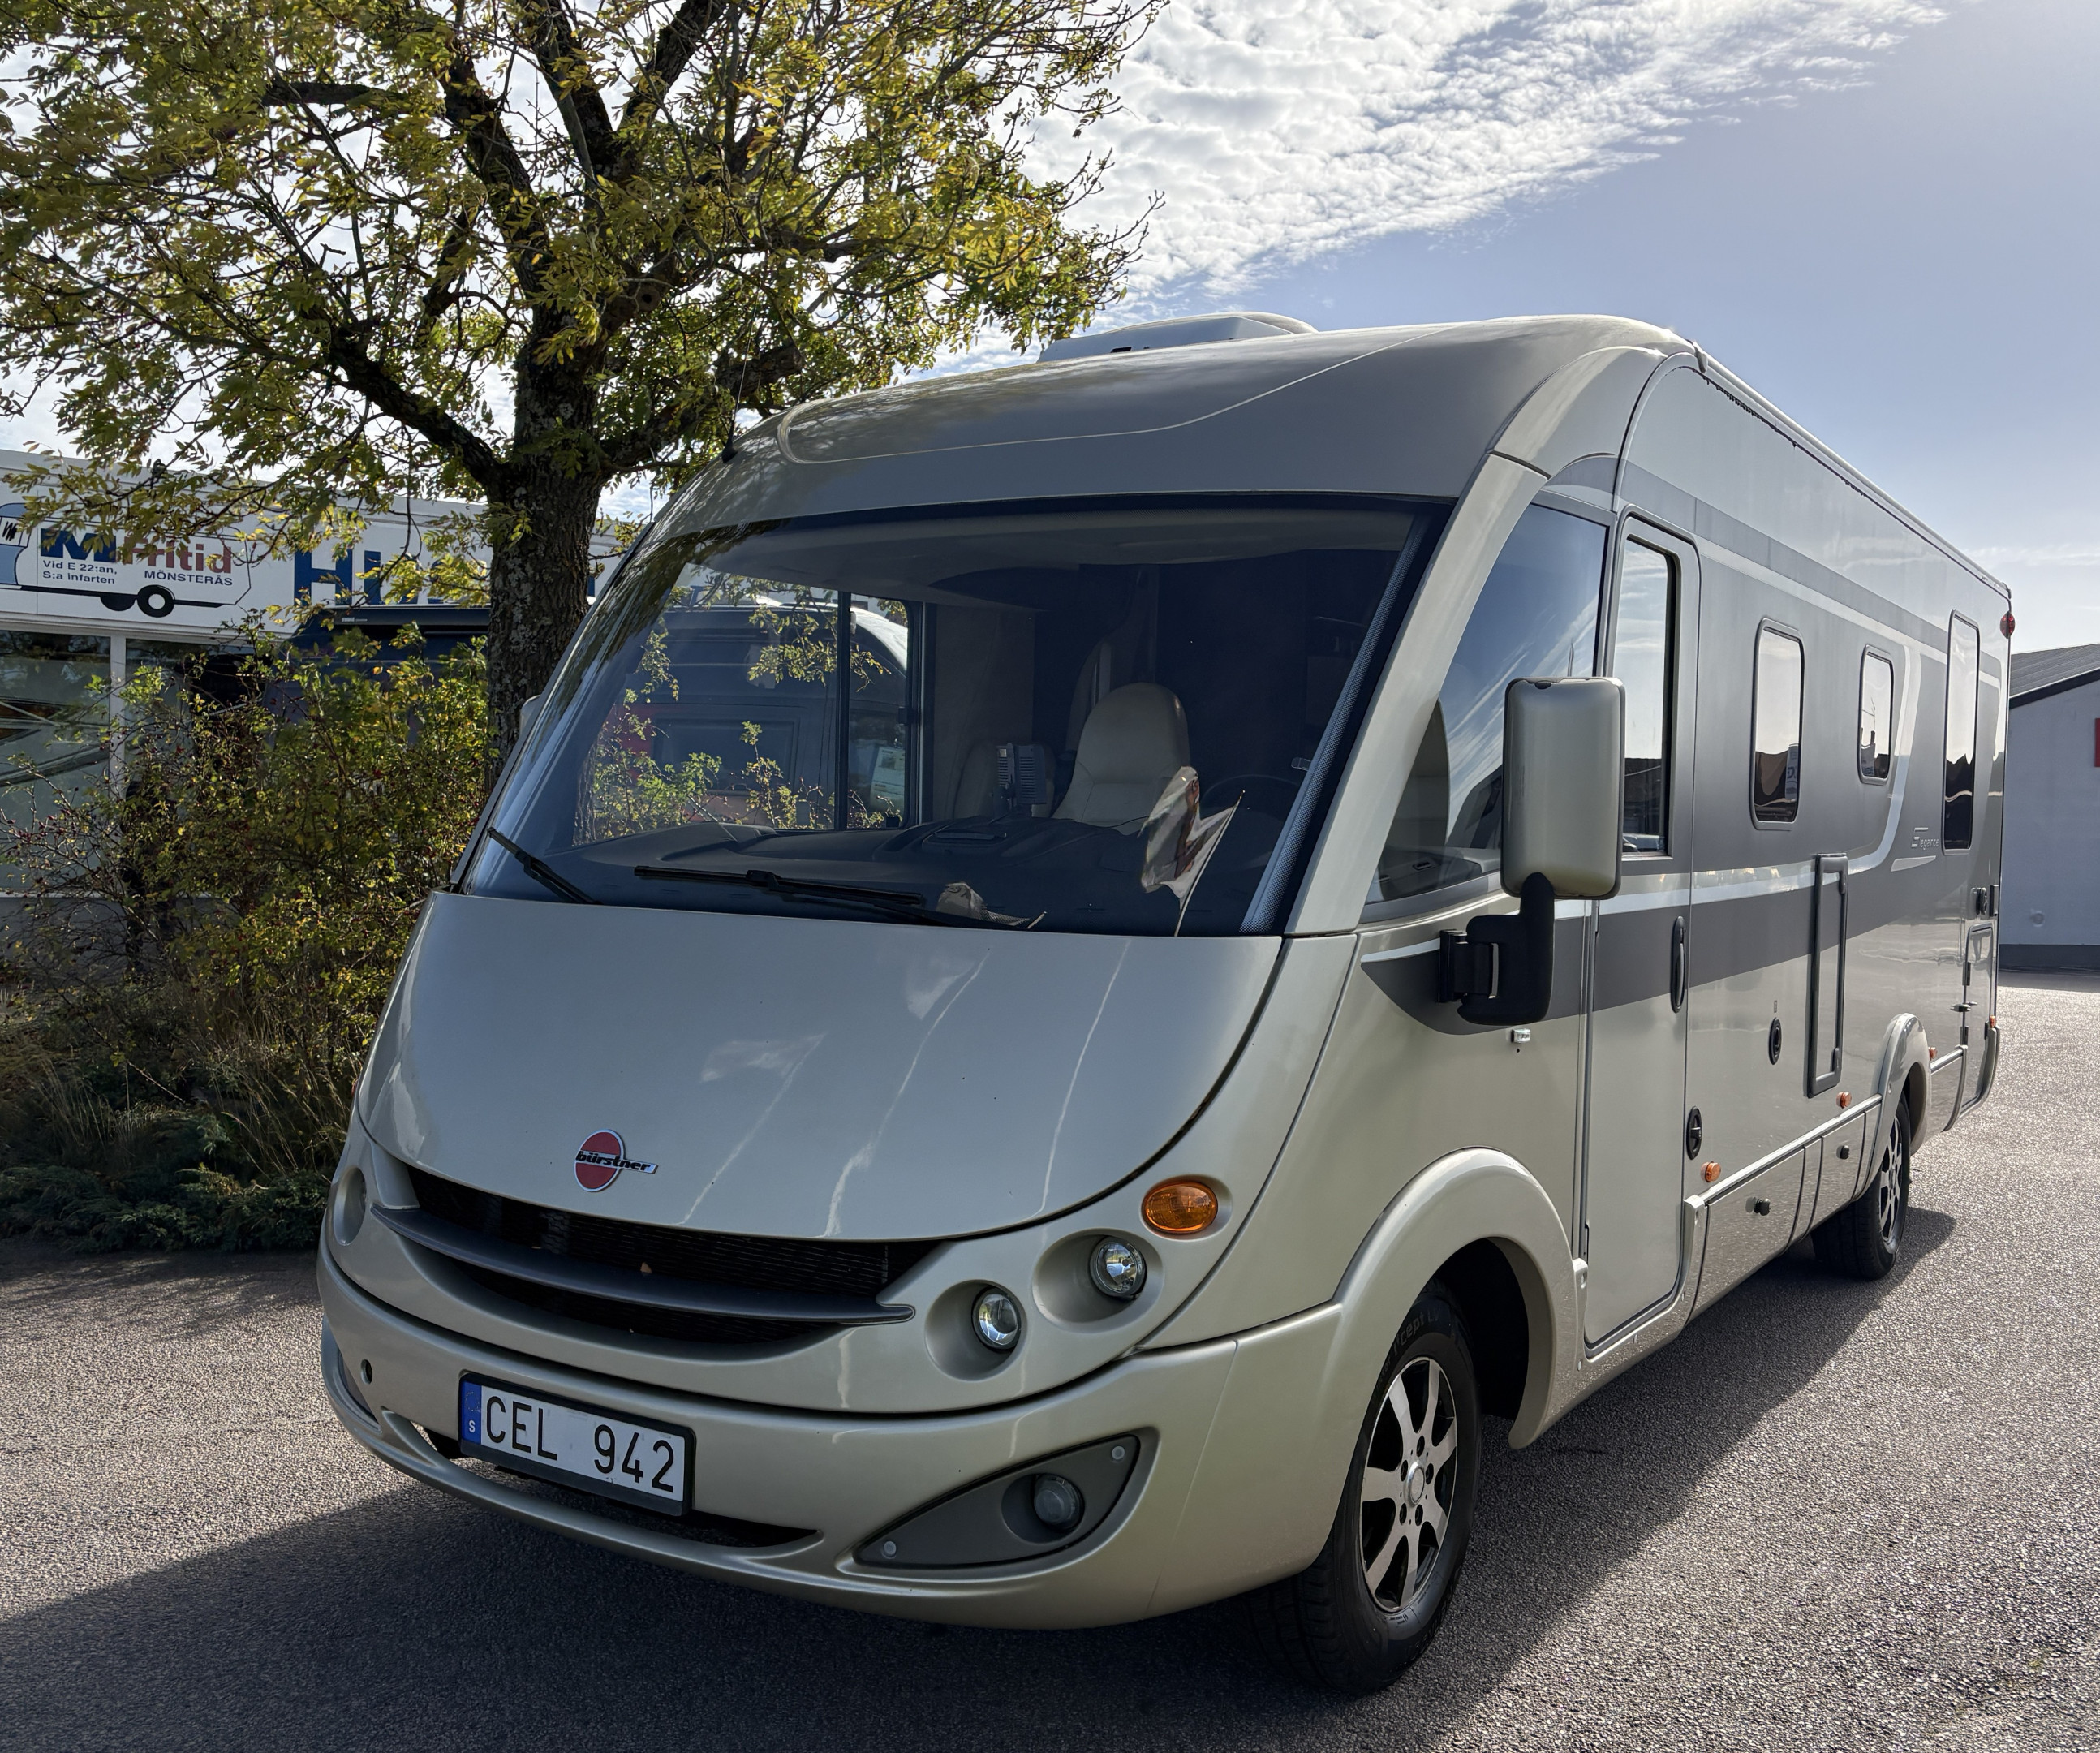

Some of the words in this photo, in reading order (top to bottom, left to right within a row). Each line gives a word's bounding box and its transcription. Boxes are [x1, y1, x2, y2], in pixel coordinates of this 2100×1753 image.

[43, 559, 63, 569] Vid
[67, 562, 76, 571] E
[80, 563, 118, 575] 22:an,
[42, 571, 63, 580] S:a
[67, 572, 115, 584] infarten
[144, 570, 233, 586] MÖNSTERÅS
[574, 1150, 652, 1171] bürstner
[467, 1419, 476, 1434] S
[486, 1395, 558, 1462] CEL
[593, 1424, 674, 1494] 942
